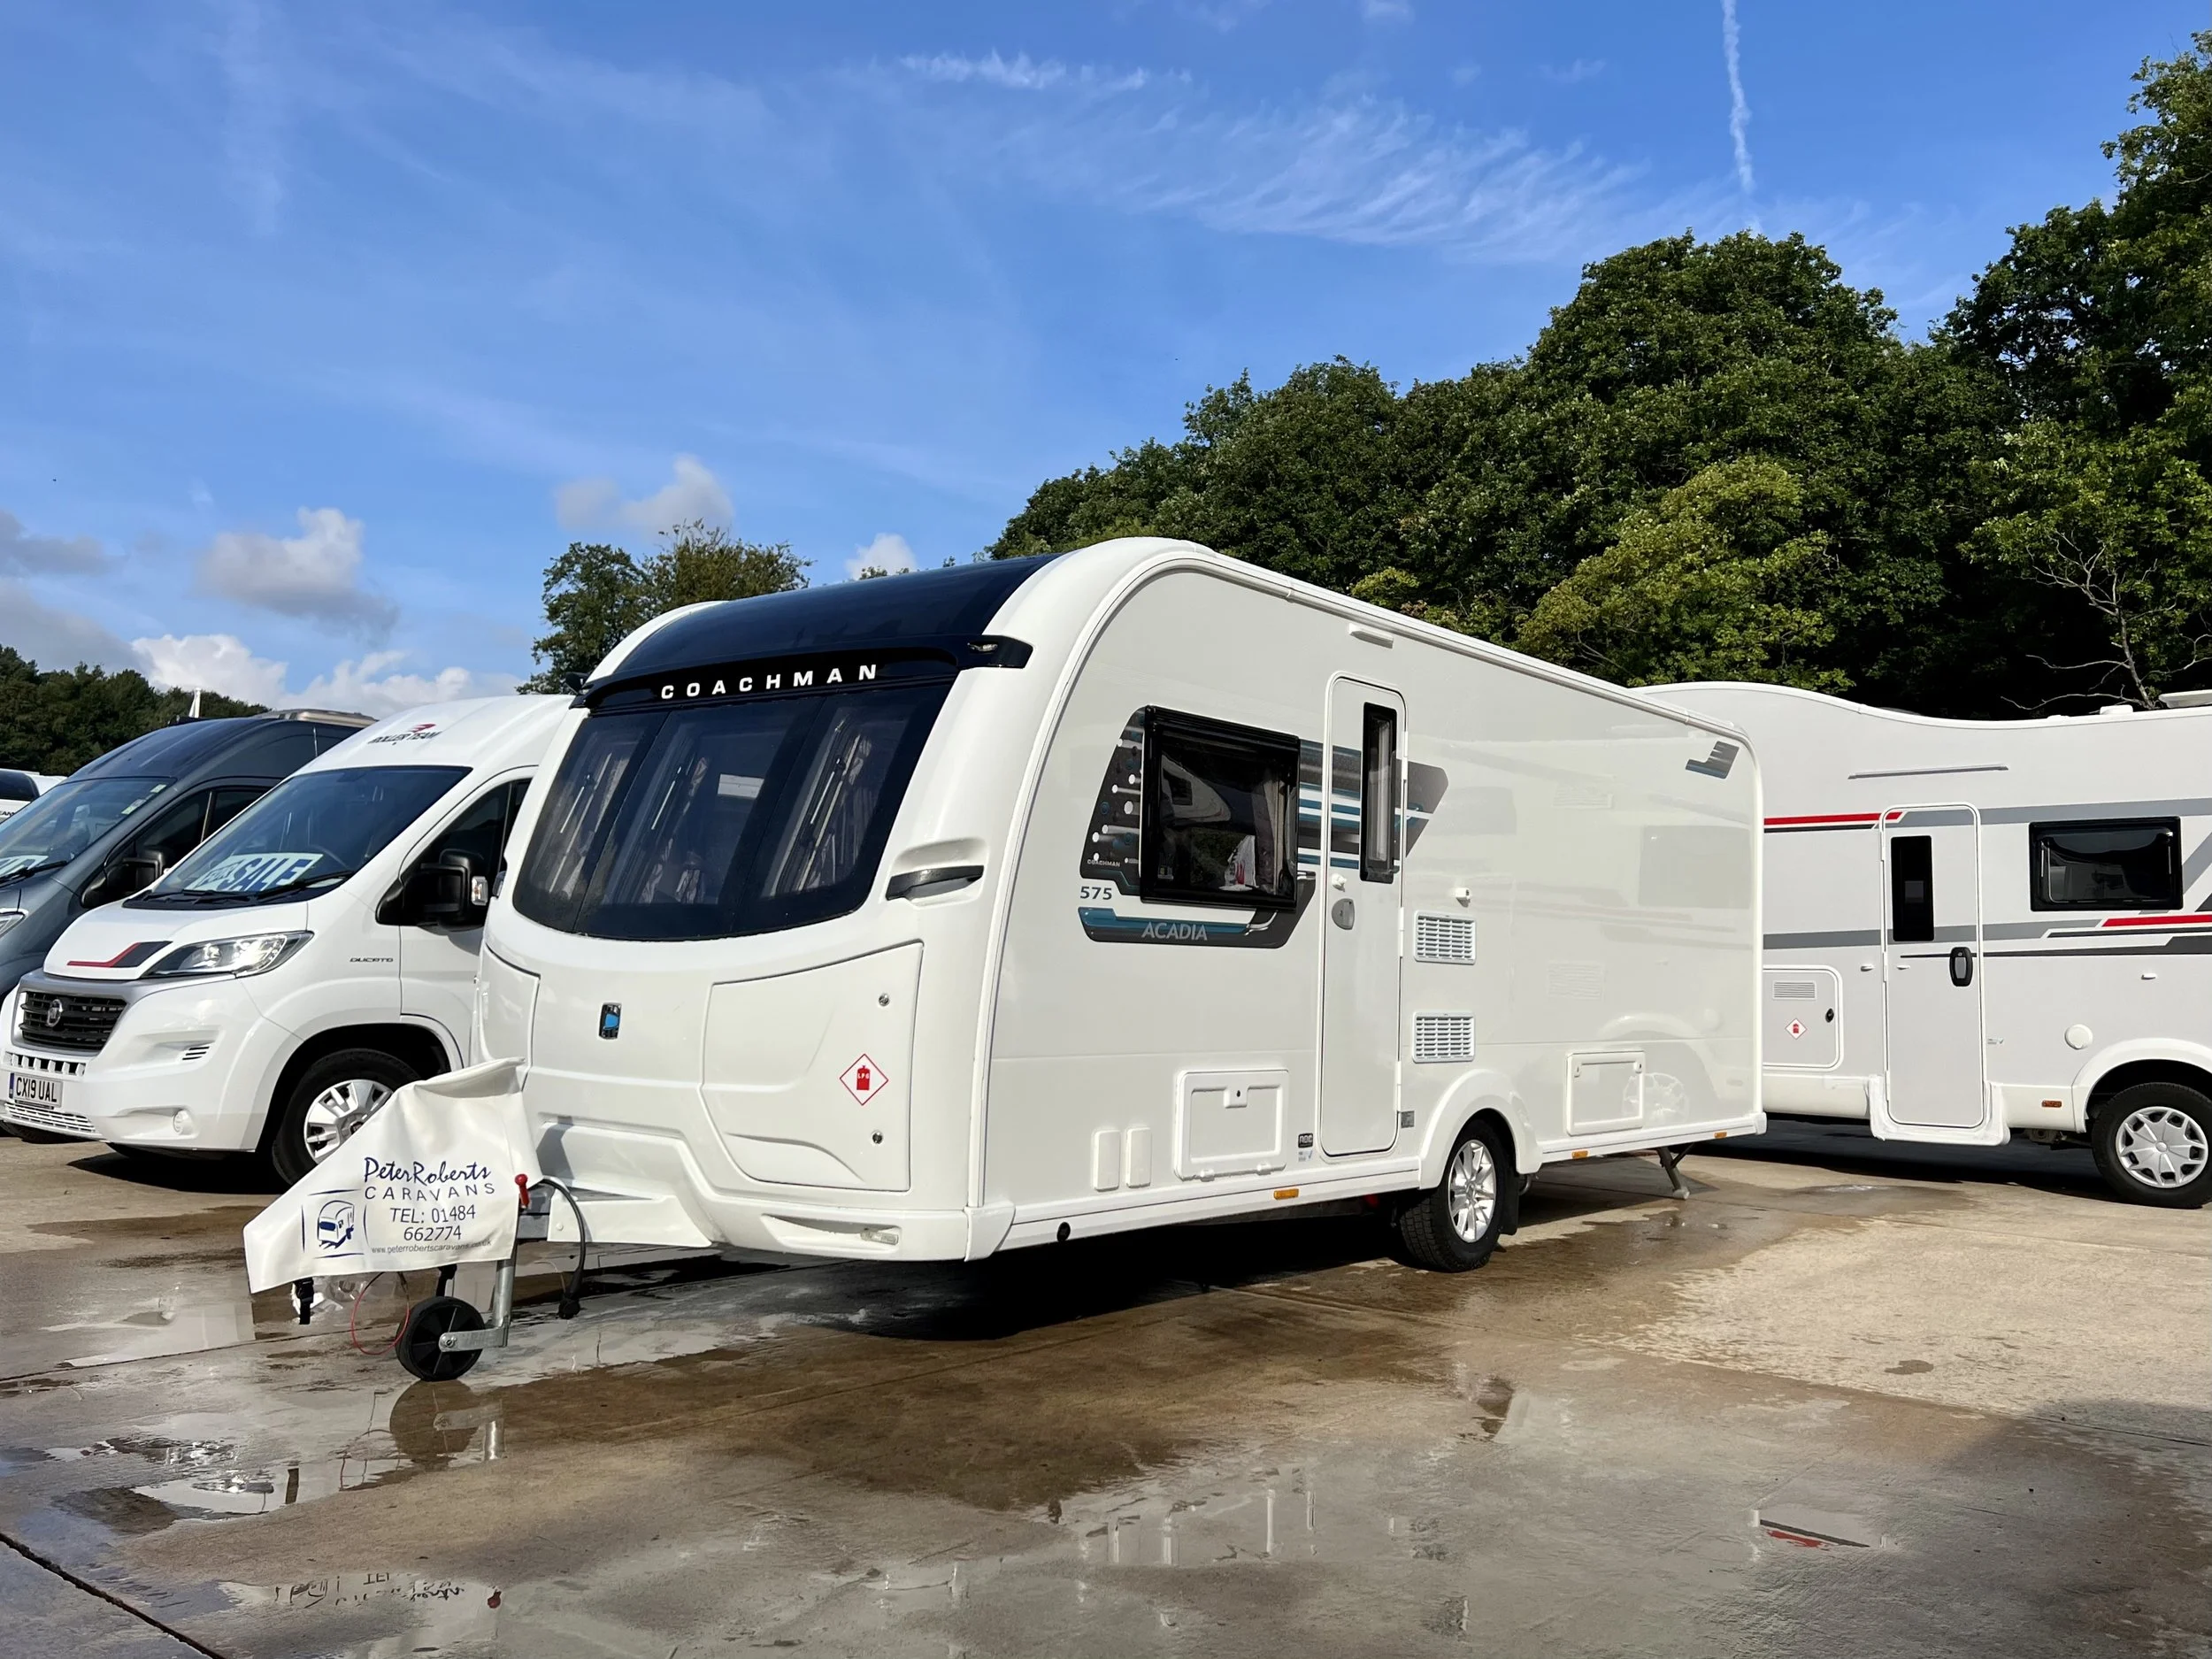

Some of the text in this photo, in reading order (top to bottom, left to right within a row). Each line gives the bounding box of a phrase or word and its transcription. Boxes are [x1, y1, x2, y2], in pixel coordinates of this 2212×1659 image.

[661, 664, 876, 699] COACHMAN
[1079, 886, 1112, 900] 575
[1141, 922, 1208, 941] ACADIA
[16, 1077, 58, 1102] CX19 UAL
[365, 1183, 495, 1202] CARAVANS
[390, 1204, 476, 1224] TEL: 01484
[403, 1225, 462, 1241] 662774
